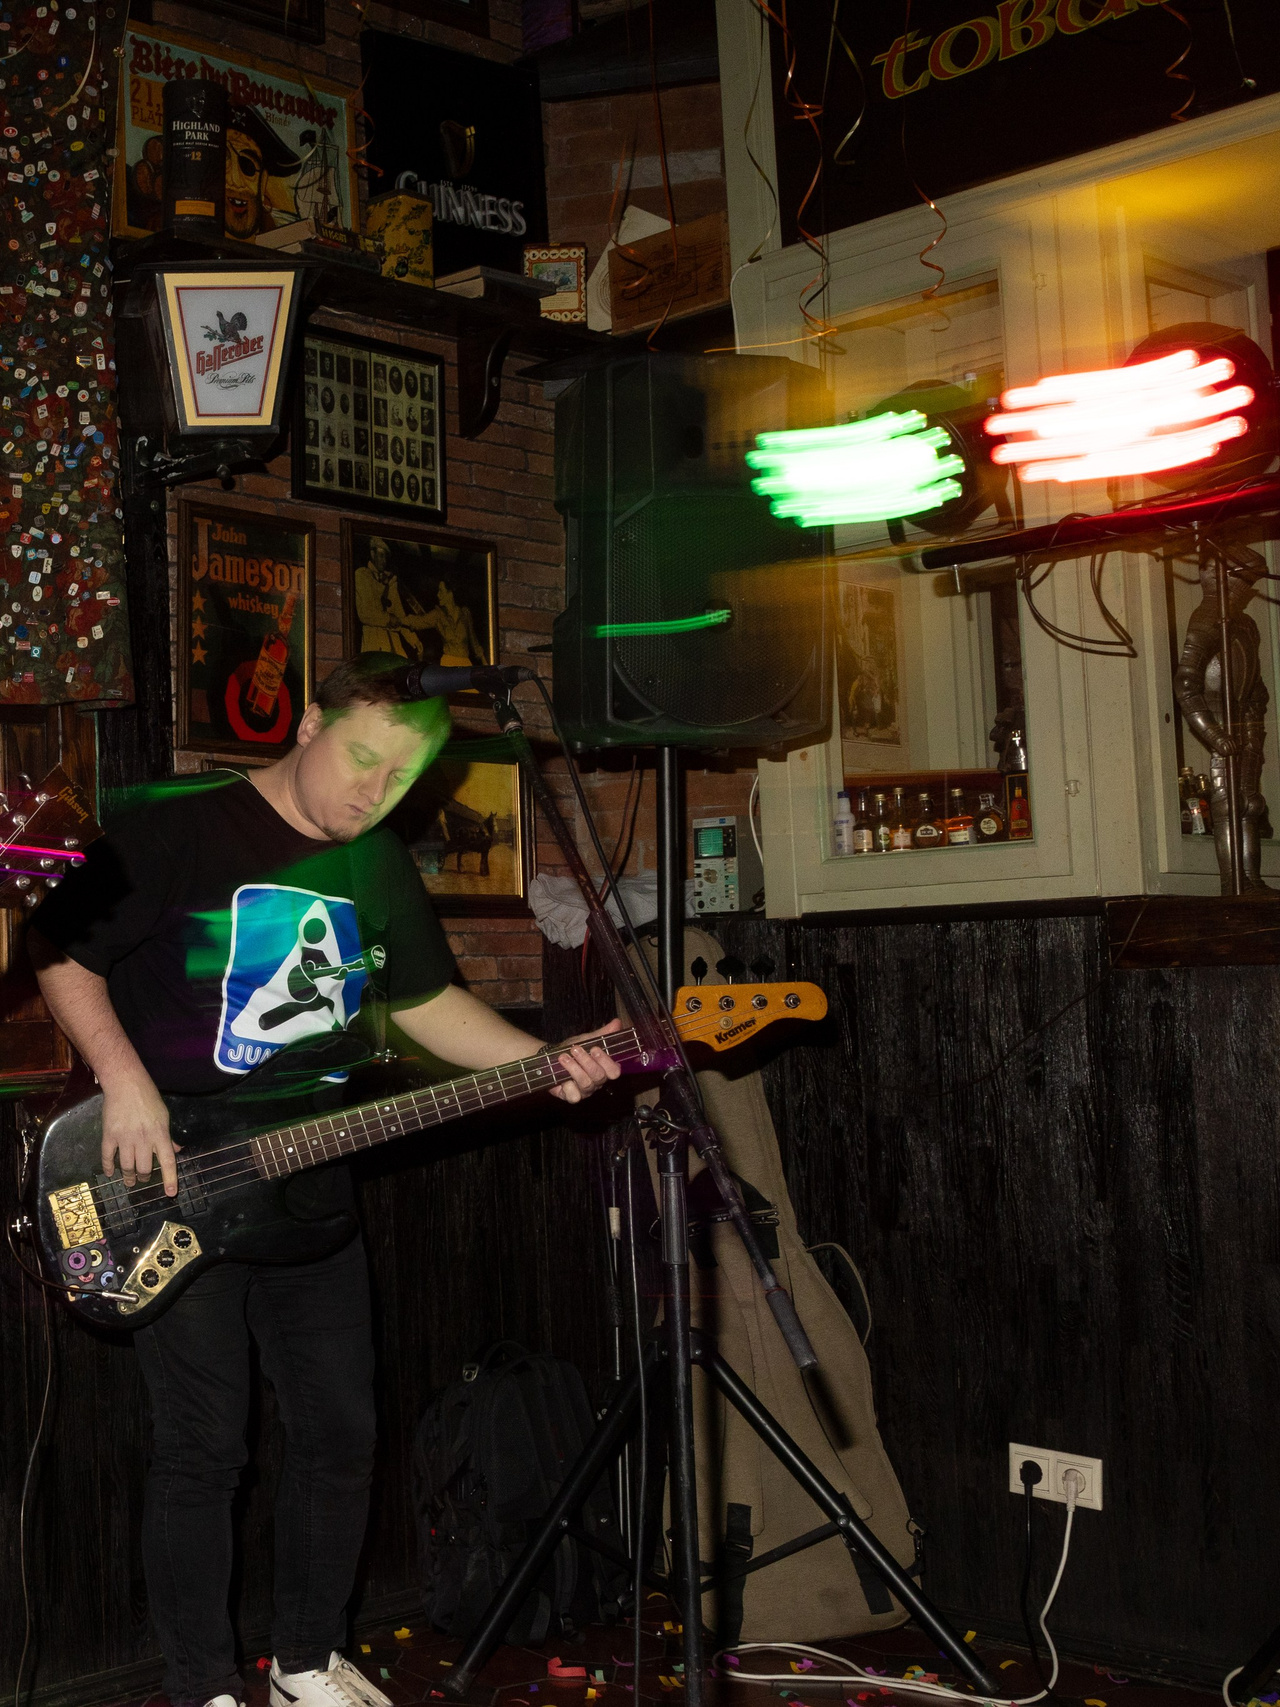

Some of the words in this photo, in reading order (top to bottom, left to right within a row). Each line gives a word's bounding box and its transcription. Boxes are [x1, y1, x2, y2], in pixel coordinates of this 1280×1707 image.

[172, 120, 221, 133] HIGHLAND
[185, 130, 209, 141] PARK
[191, 151, 202, 161] 12
[205, 371, 242, 388] Premium
[239, 372, 256, 385] Pils
[211, 522, 248, 546] John
[192, 516, 305, 594] Jameson
[228, 592, 280, 619] whiskey
[57, 786, 89, 824] Gibson
[714, 1017, 756, 1044] Kramer
